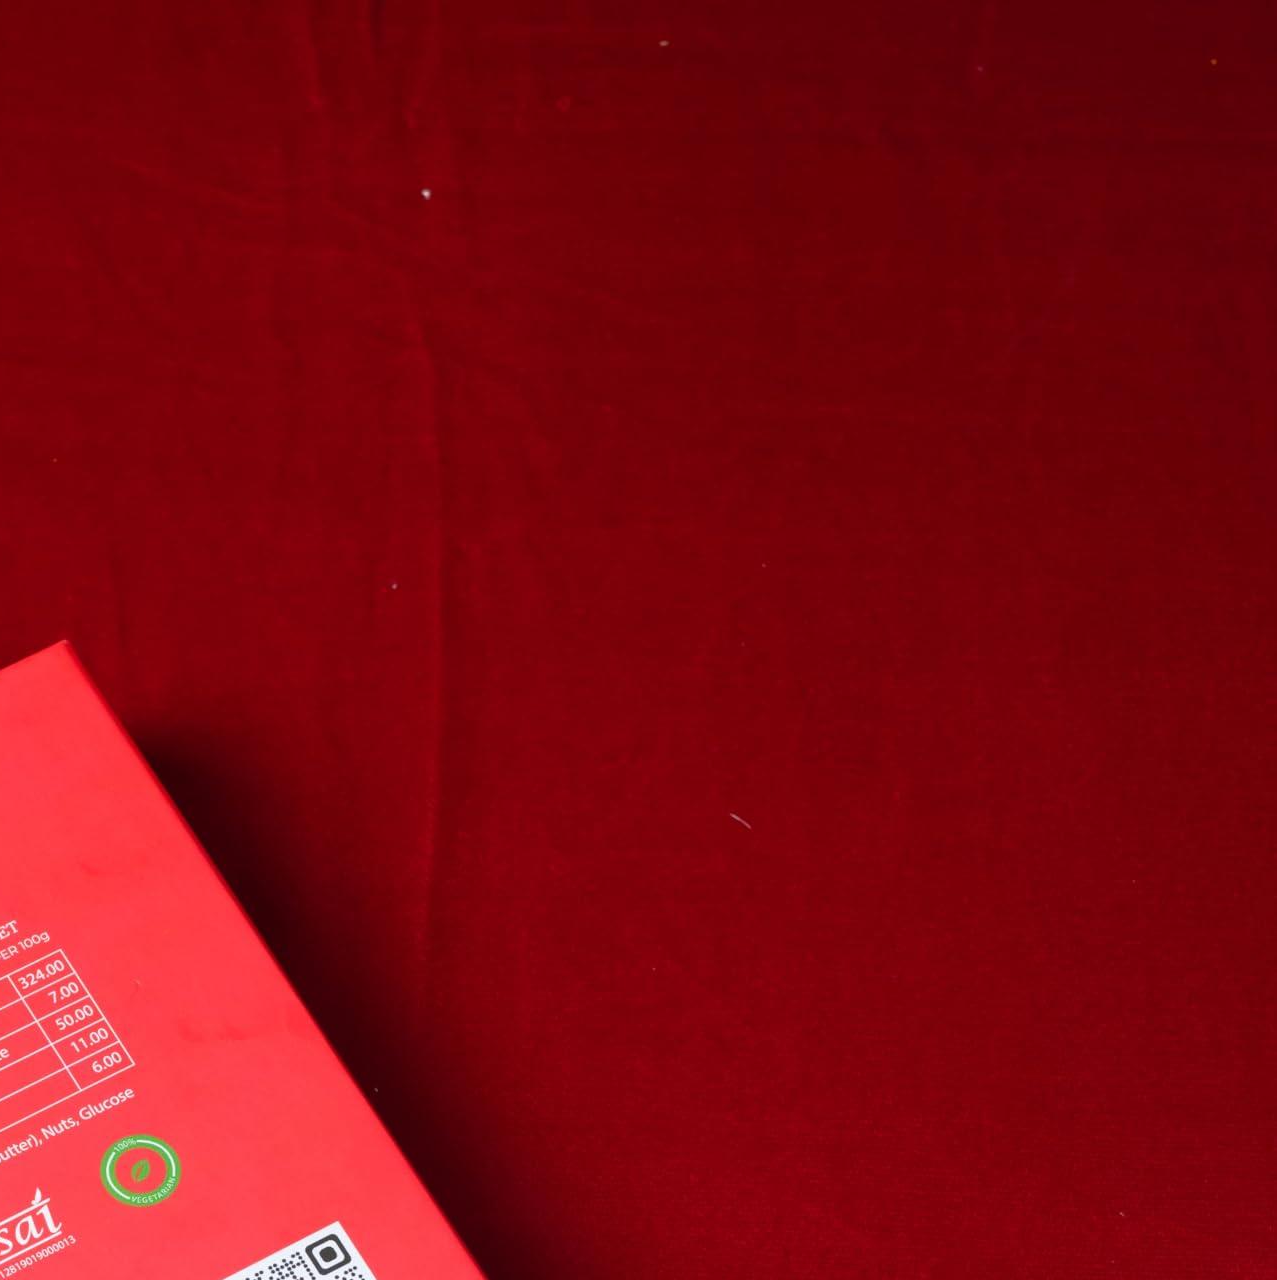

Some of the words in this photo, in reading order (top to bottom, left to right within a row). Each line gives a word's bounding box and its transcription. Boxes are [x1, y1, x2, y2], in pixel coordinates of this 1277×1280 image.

[17, 931, 51, 950] 100g
[18, 959, 65, 990] 324.00
[47, 981, 79, 1004] 7.00
[54, 1004, 94, 1031] 50.00
[70, 1027, 109, 1053] 11.00
[91, 1051, 123, 1073] 6.00
[40, 1117, 80, 1140] Nuts,
[78, 1088, 135, 1121] Glucose
